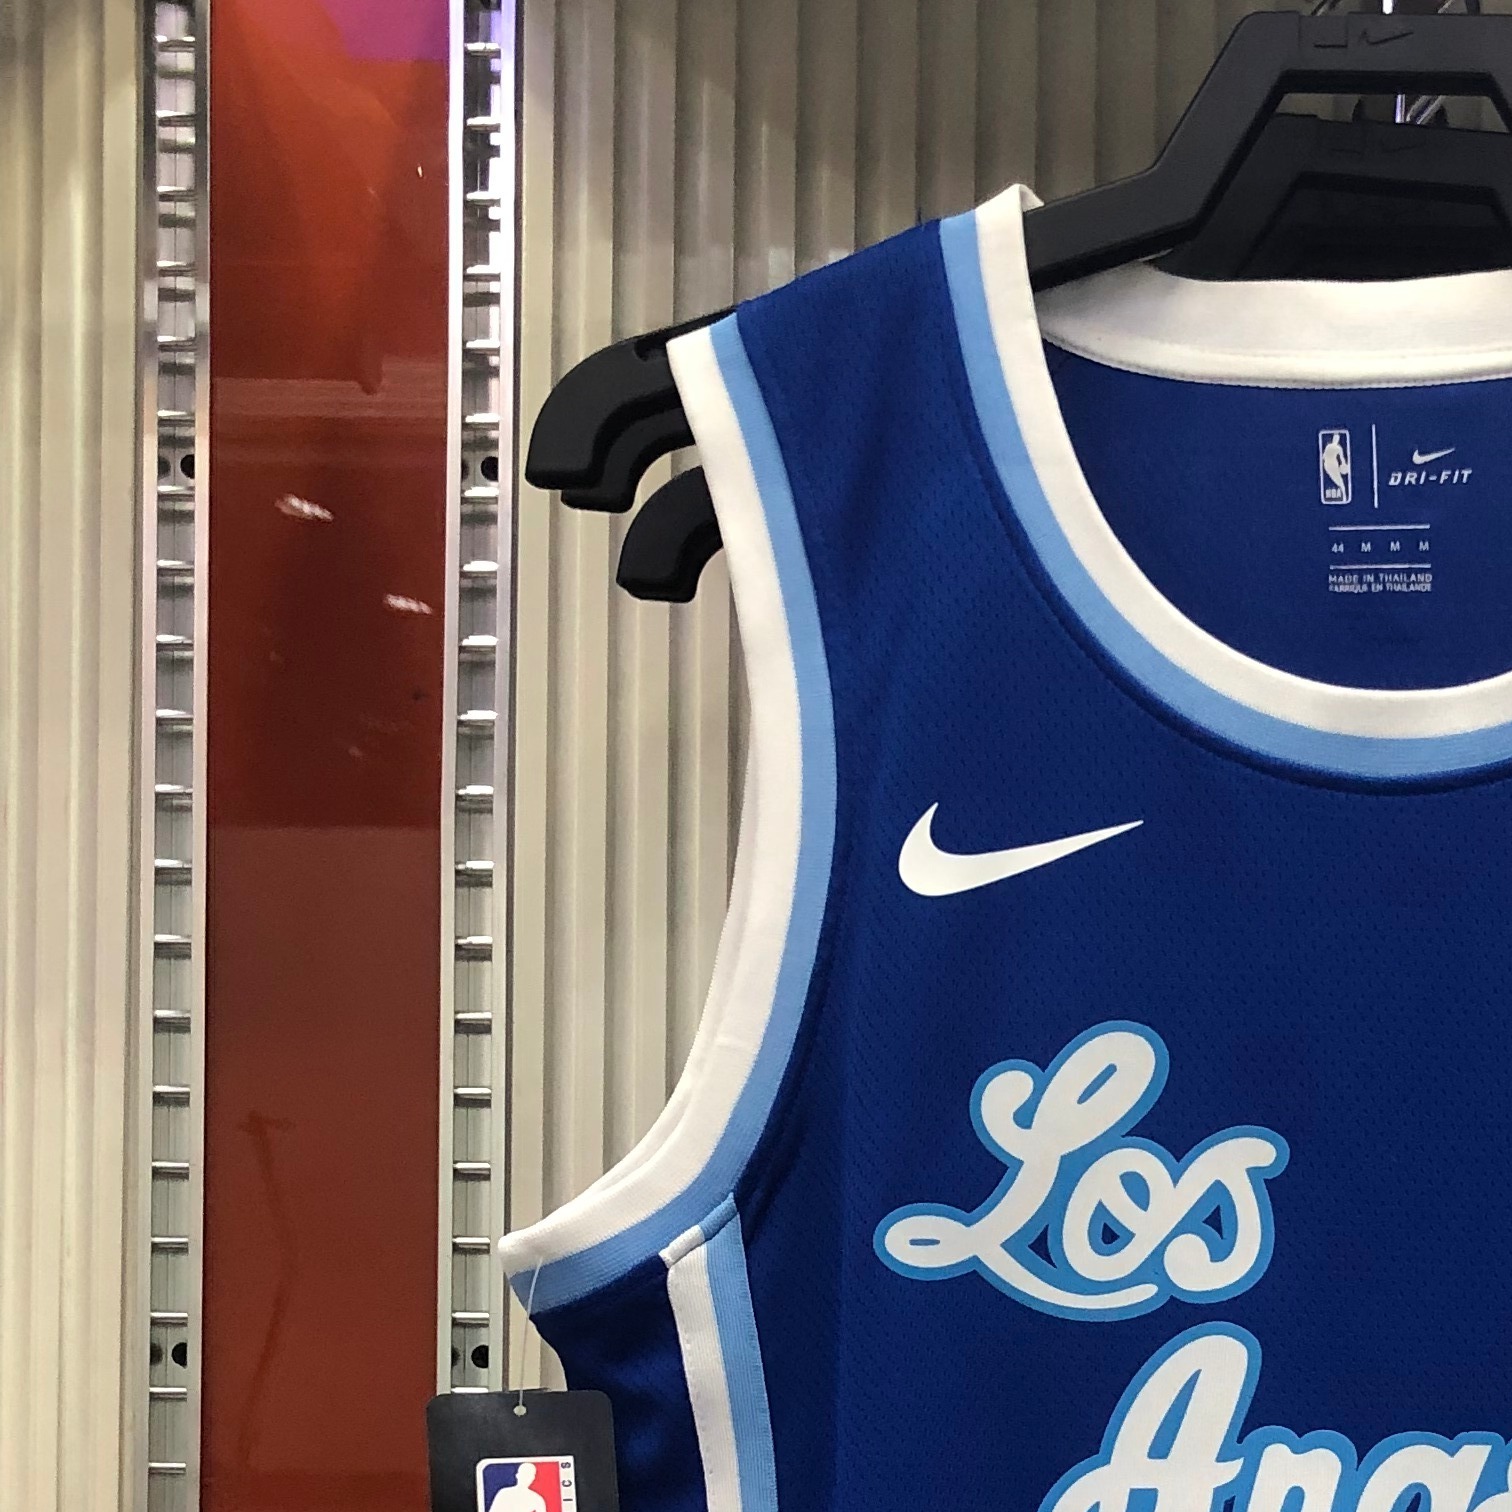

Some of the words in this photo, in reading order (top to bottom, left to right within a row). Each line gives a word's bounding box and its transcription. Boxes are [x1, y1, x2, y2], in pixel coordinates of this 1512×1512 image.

[1388, 468, 1473, 486] DRI-FIT
[1331, 543, 1344, 553] 44
[1360, 541, 1372, 552] M
[1390, 541, 1401, 552] M
[1419, 541, 1430, 551] M
[1328, 573, 1359, 584] MADE
[1363, 573, 1374, 583] IN
[1378, 573, 1433, 583] THAILAND
[873, 1020, 1290, 1321] Los
